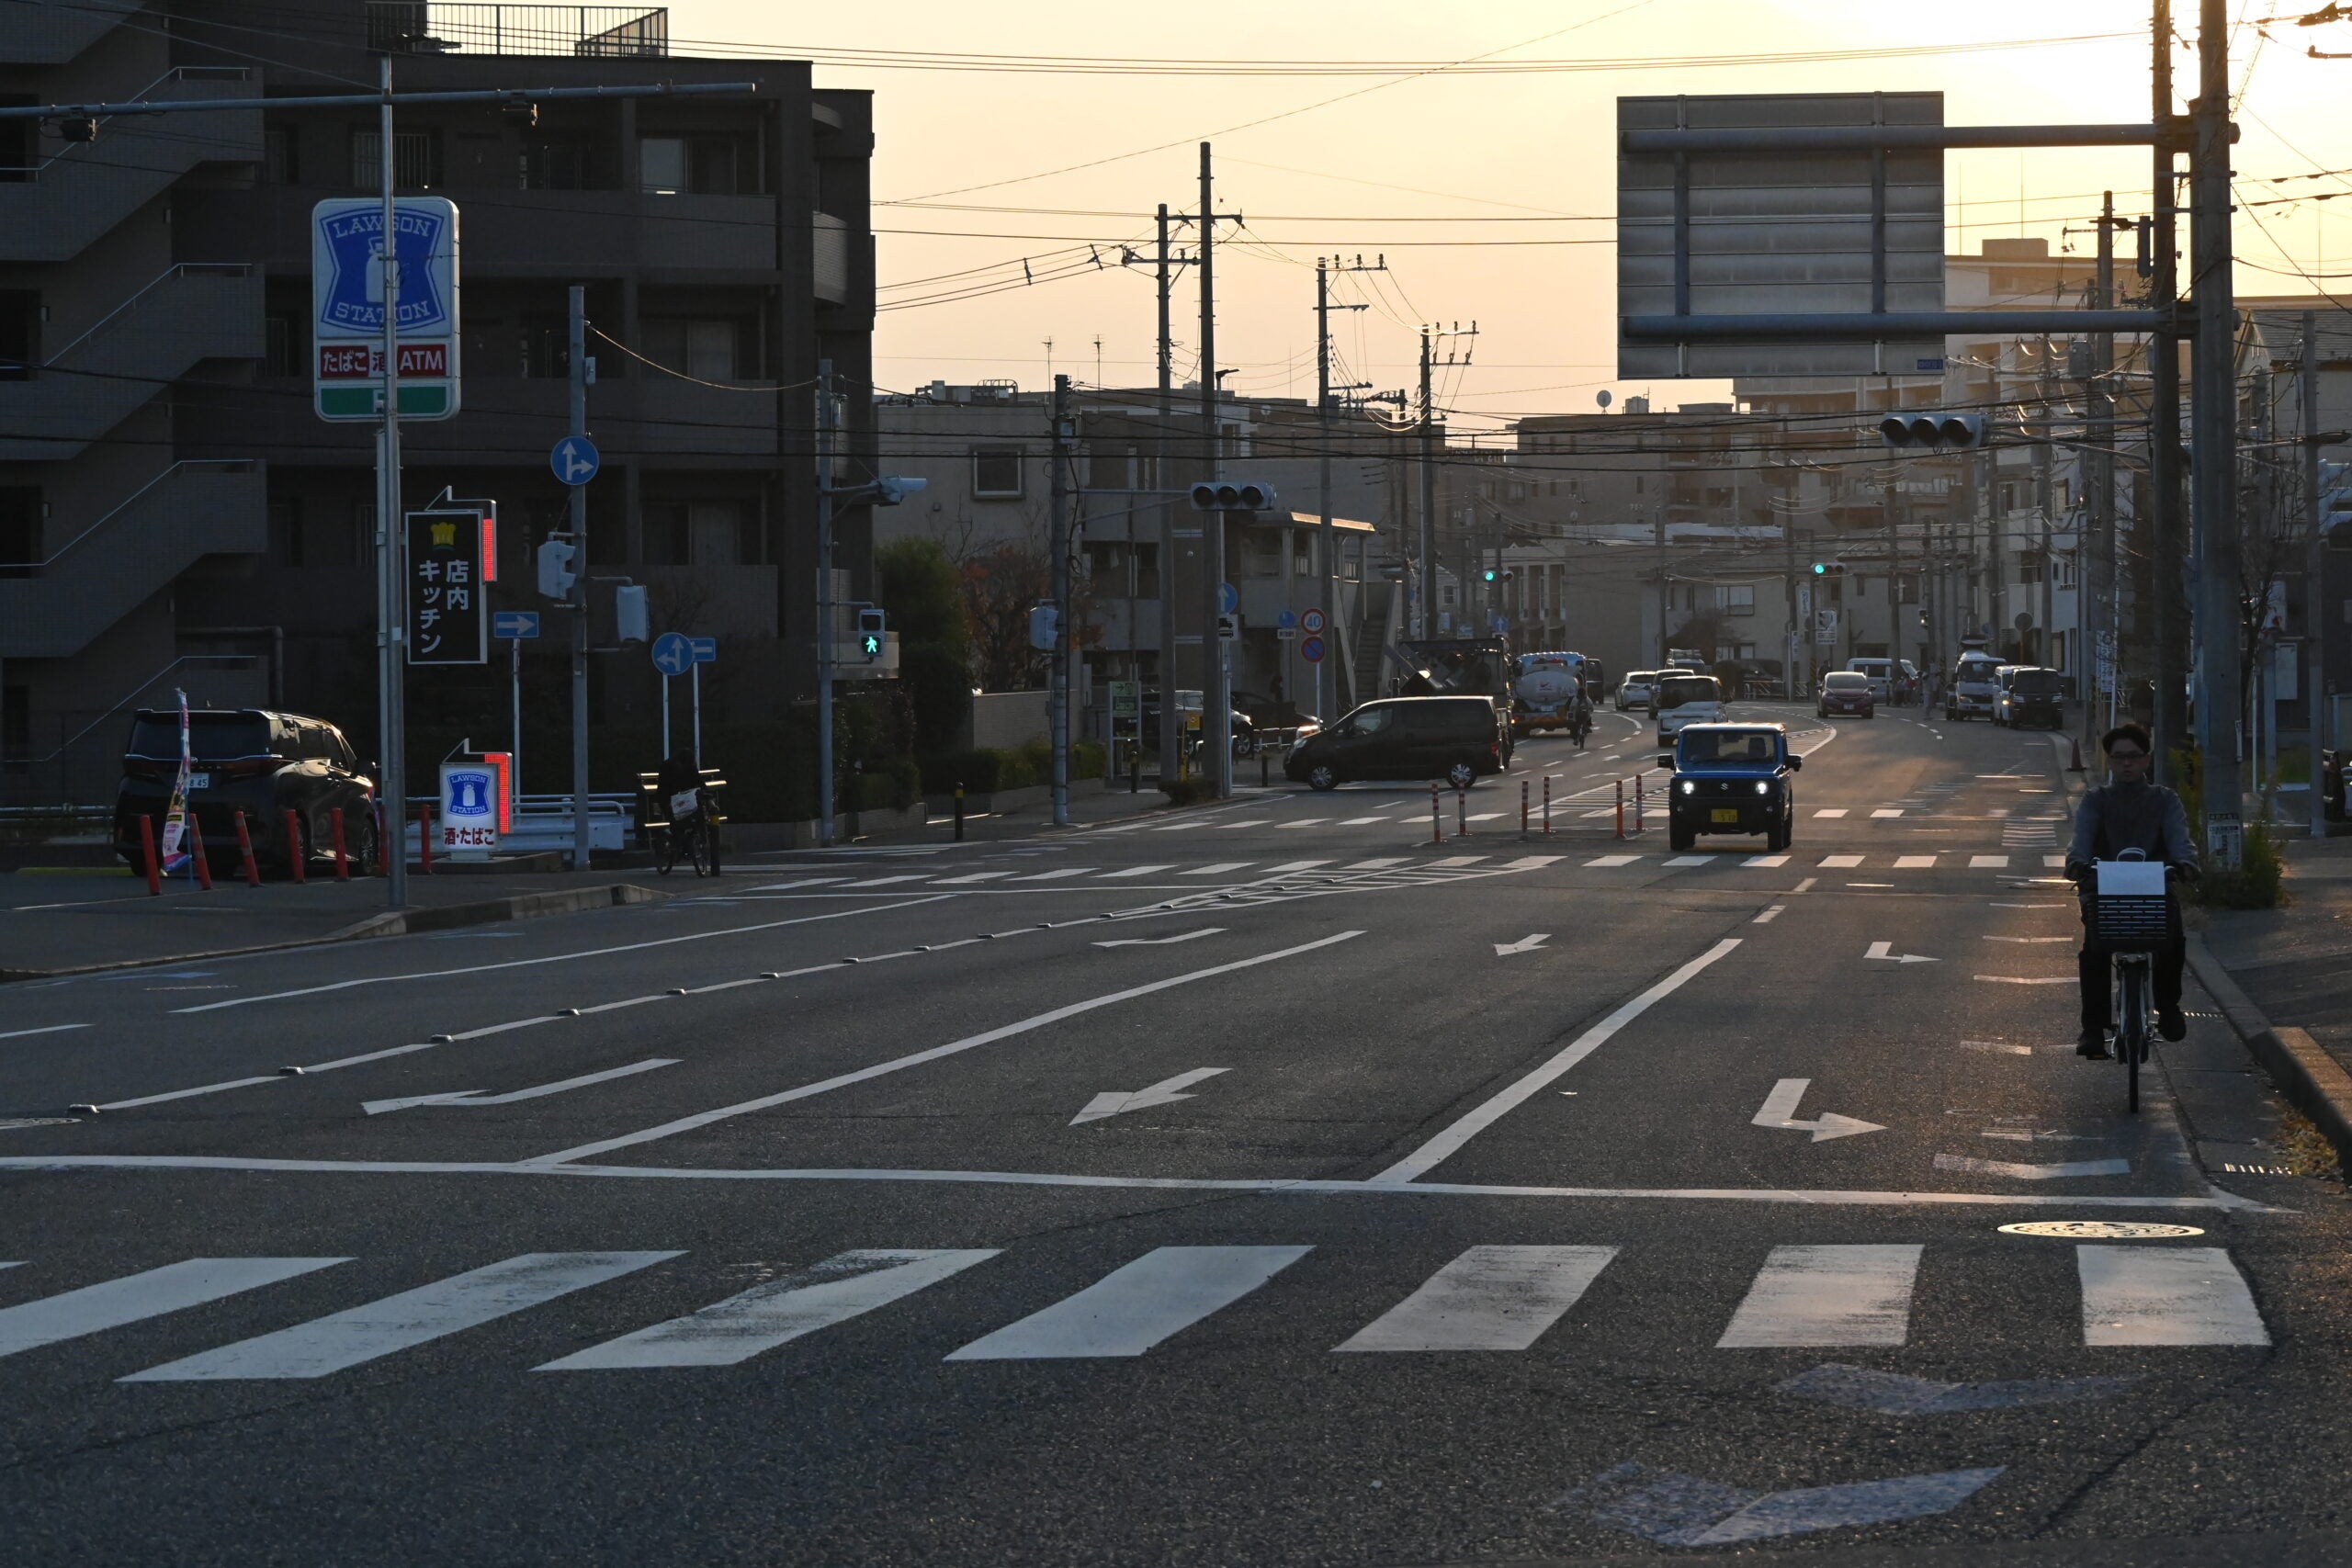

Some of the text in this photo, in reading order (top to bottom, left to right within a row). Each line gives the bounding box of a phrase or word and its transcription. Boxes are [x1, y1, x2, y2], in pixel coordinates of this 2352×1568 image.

[323, 349, 368, 372] たばこ
[399, 350, 443, 371] ATM
[446, 558, 469, 611] 店内
[418, 559, 442, 654] キッチン
[1306, 615, 1321, 627] 40
[450, 774, 487, 784] LAWSON
[451, 805, 487, 814] STATION
